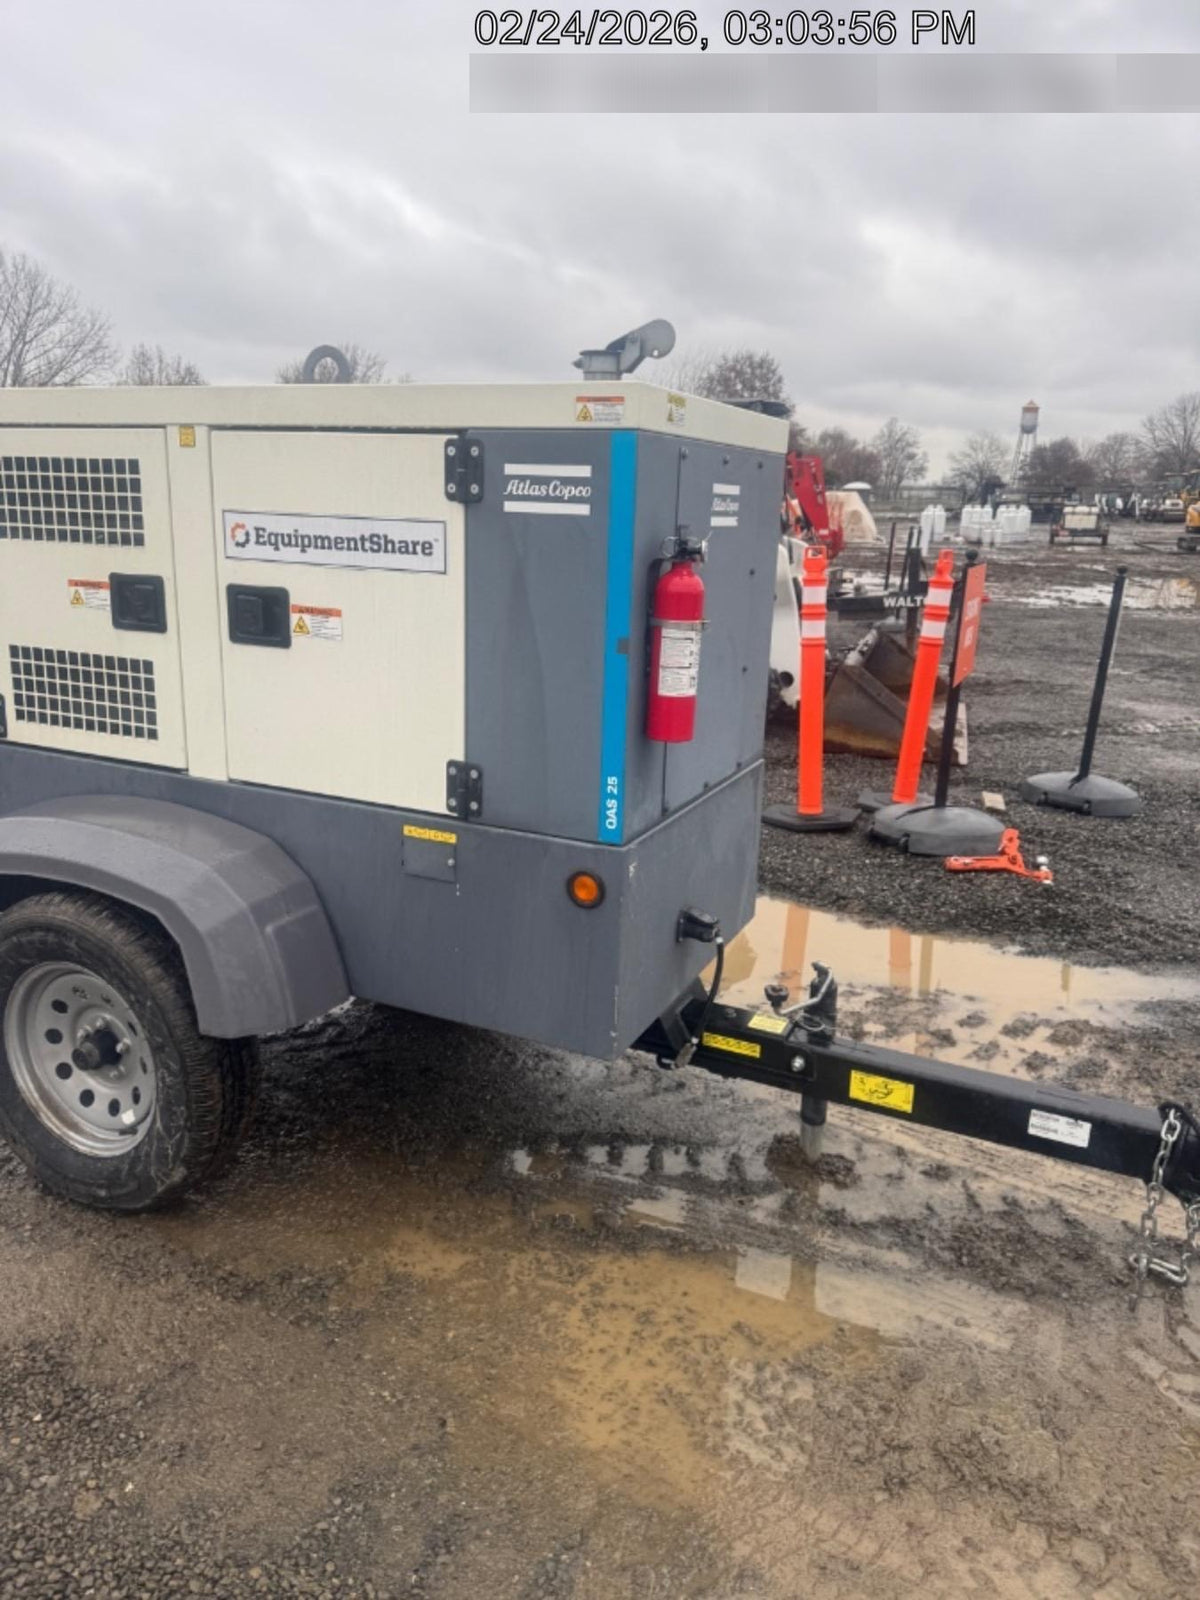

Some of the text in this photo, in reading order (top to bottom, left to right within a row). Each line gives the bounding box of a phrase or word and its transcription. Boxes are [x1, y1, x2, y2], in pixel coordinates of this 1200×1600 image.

[503, 479, 591, 500] Atlas Copco
[254, 526, 434, 557] EquipmentShare
[883, 596, 925, 607] WALT
[607, 776, 618, 795] 25
